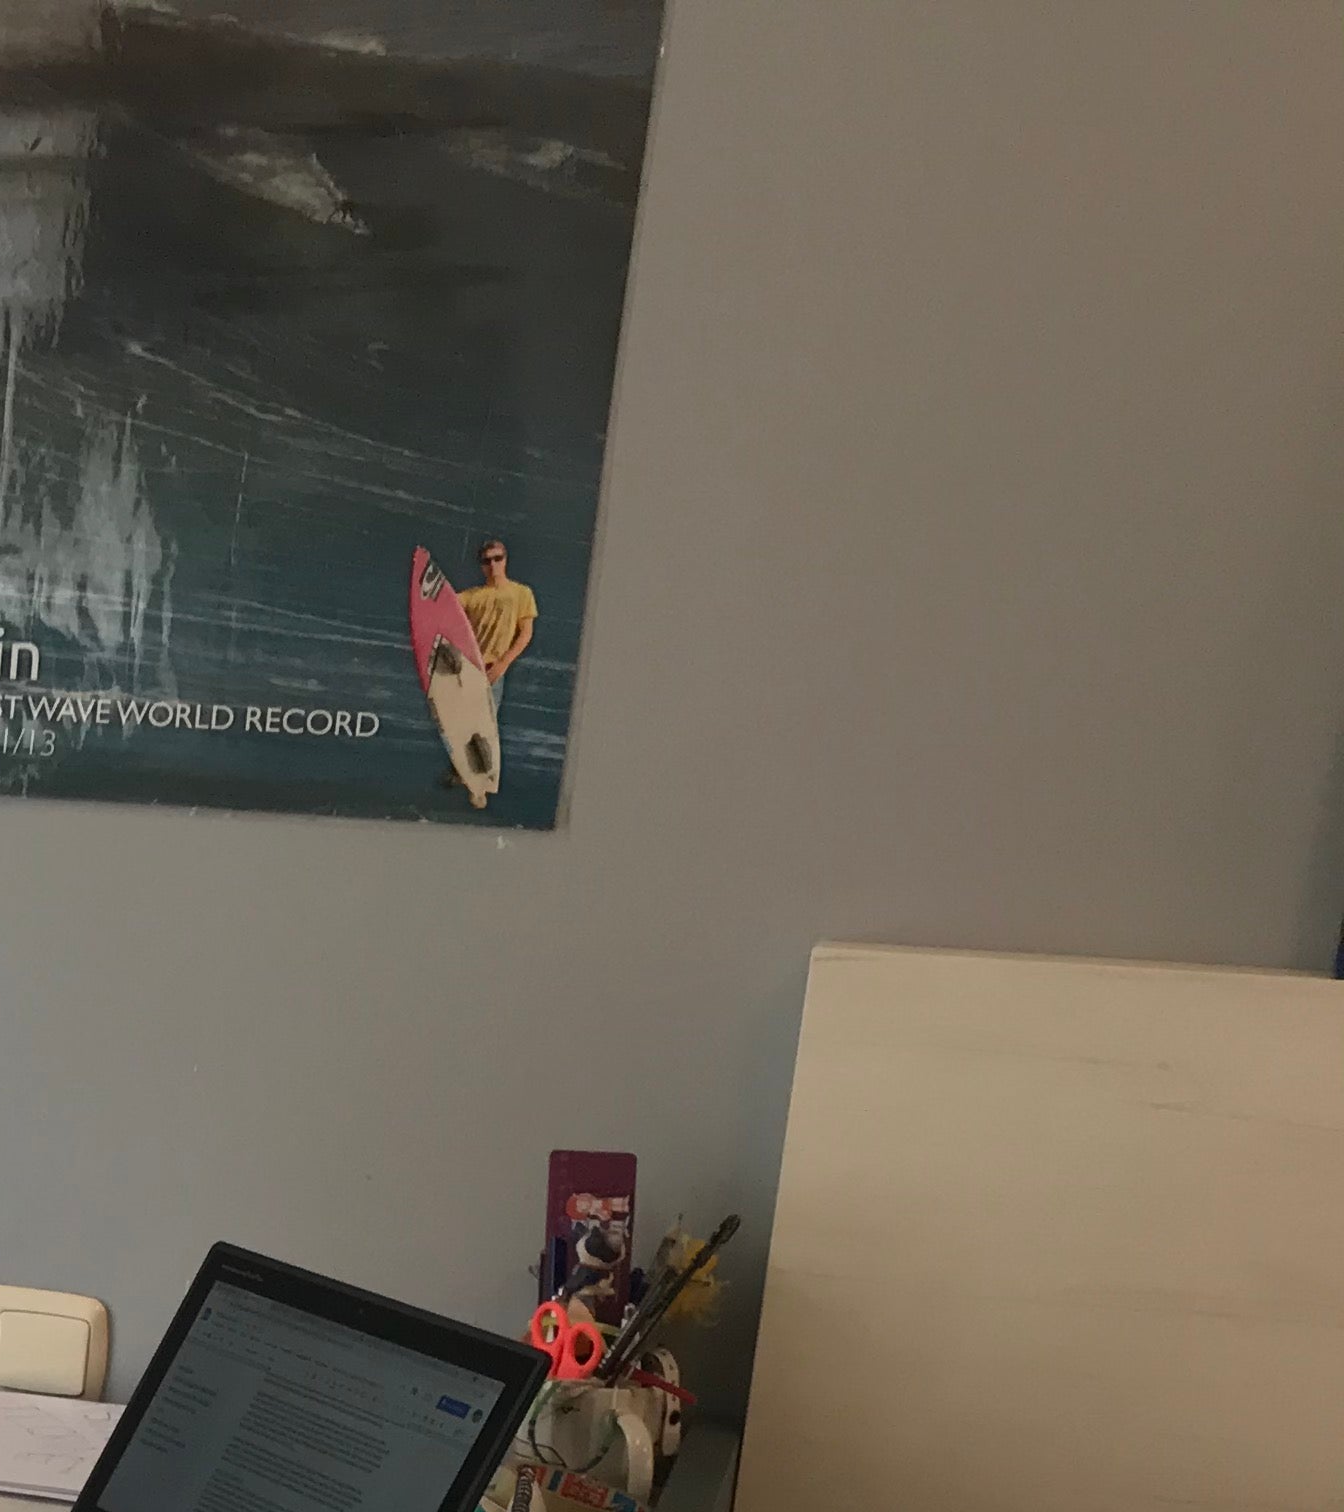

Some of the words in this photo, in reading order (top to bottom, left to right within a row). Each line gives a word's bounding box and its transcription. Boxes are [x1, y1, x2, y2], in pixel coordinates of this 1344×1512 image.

[28, 695, 112, 725] WAVE
[116, 699, 235, 731] WORLD
[244, 706, 381, 738] RECORD
